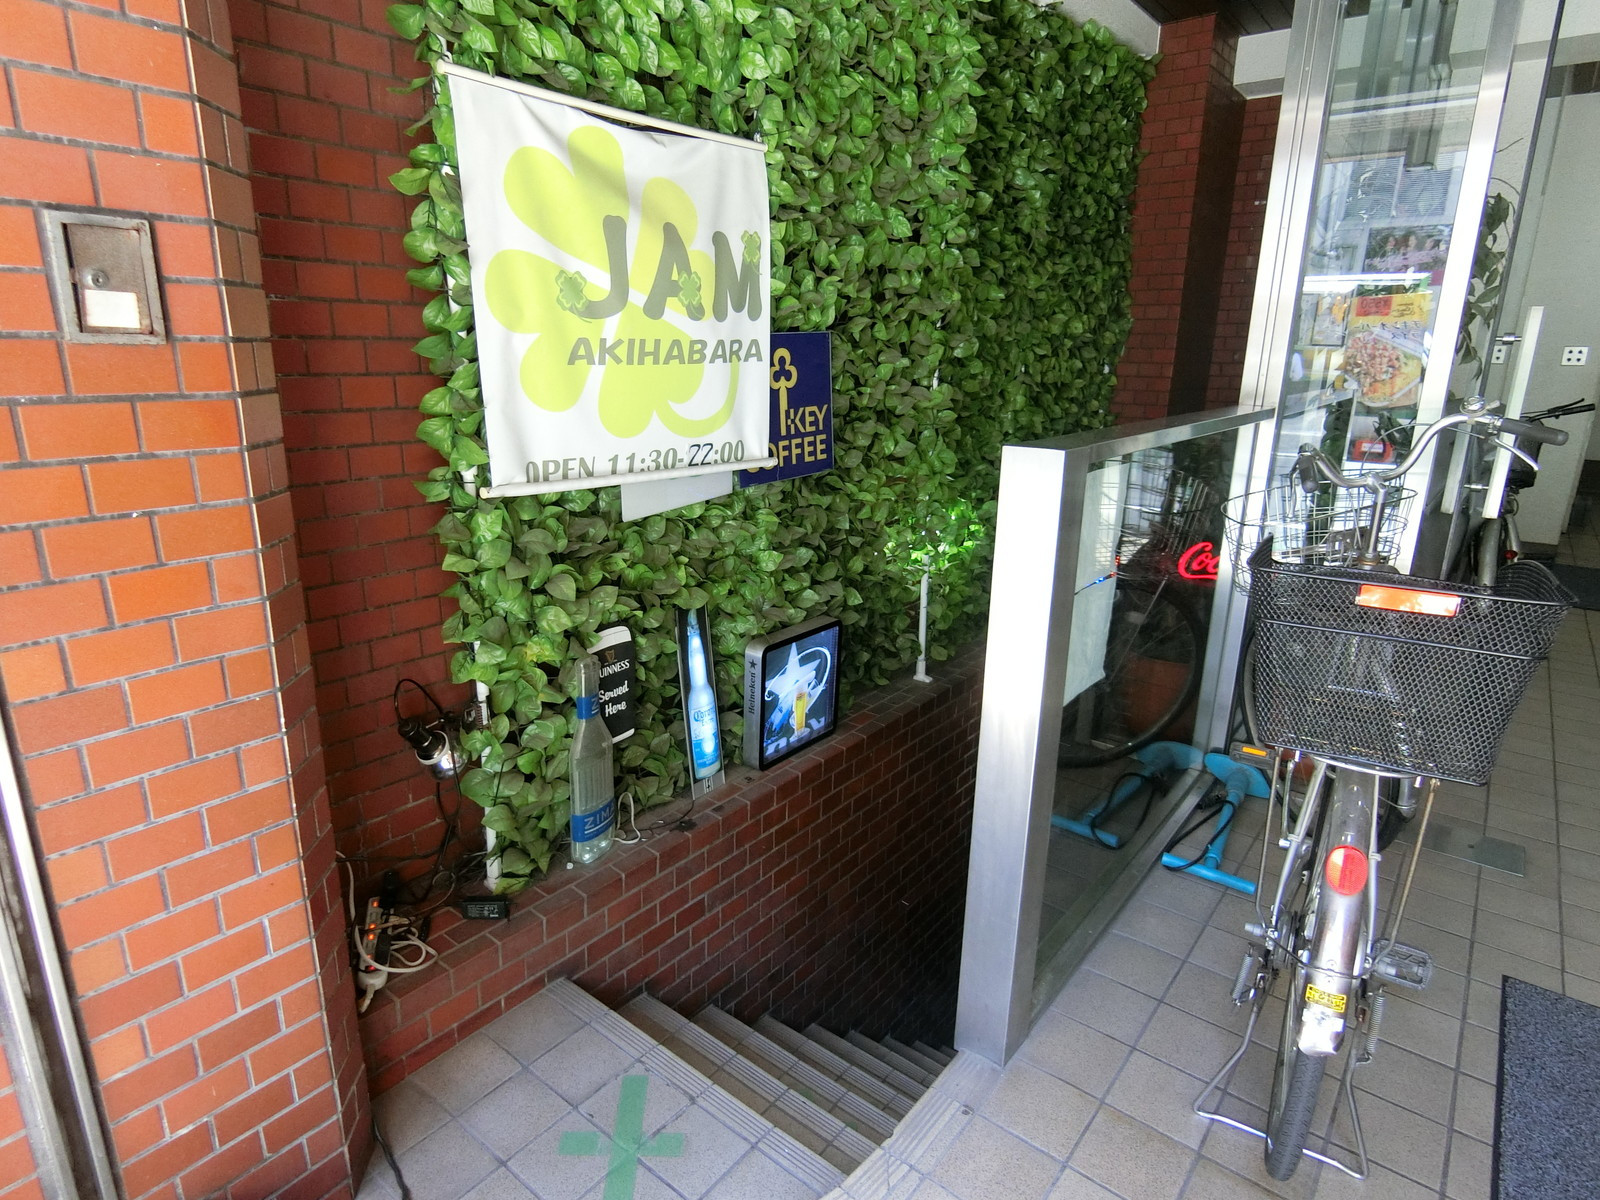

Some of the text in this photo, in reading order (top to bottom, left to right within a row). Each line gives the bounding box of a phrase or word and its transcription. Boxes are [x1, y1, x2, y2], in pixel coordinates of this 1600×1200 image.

[556, 214, 762, 323] JAM
[567, 336, 763, 366] AKIHABARA
[787, 404, 829, 435] KEY
[608, 440, 745, 476] 11:30-22:00
[746, 434, 827, 474] OFFEE
[599, 660, 630, 678] UINNESS
[598, 681, 629, 701] Served
[748, 671, 756, 715] Heineken
[605, 701, 627, 717] Here
